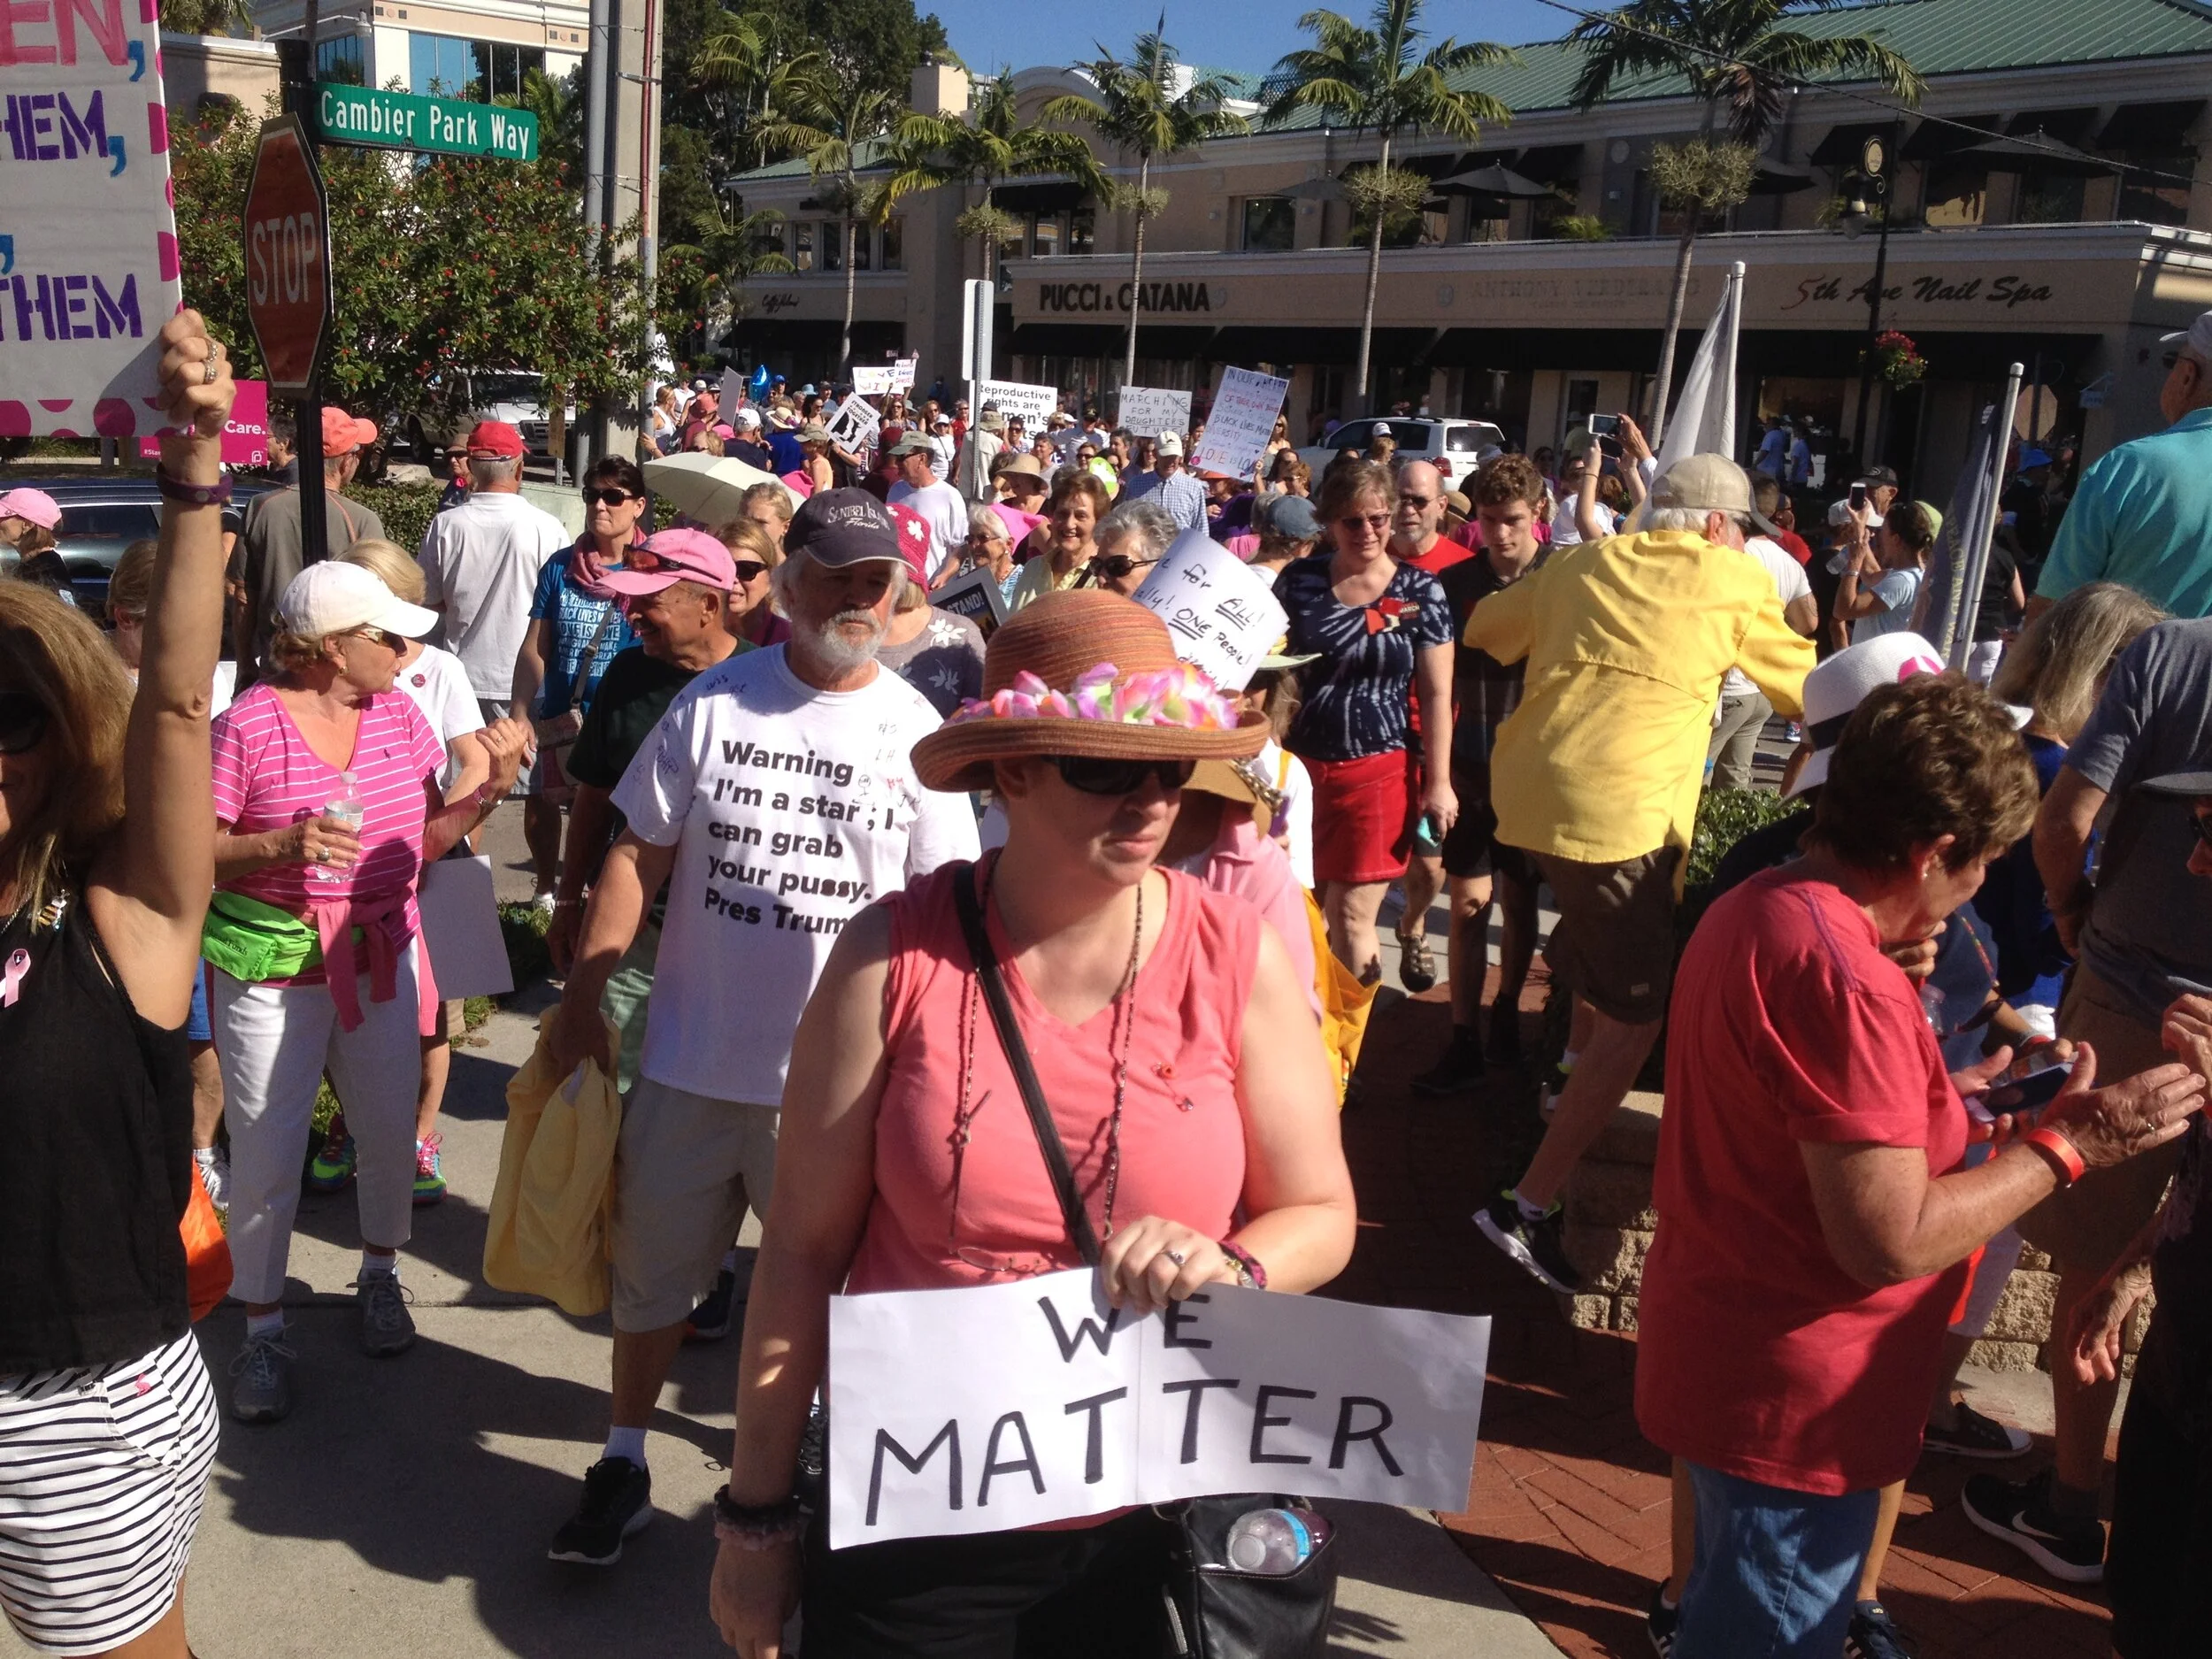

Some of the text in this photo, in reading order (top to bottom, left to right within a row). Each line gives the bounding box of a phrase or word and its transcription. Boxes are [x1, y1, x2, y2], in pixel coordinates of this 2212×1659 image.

[321, 91, 529, 159] Cambier Park Way
[252, 212, 316, 306] STOP
[1040, 282, 1210, 311] PUCCI & CATANA
[1780, 274, 1842, 310] 5th
[1912, 276, 1982, 303] Nail
[1985, 276, 2052, 309] Spa
[1121, 393, 1188, 408] MARCHING
[1162, 409, 1178, 418] MY
[224, 420, 266, 434] Care.
[1125, 416, 1185, 426] DAUGHTERS
[1213, 414, 1238, 427] BLACK
[1199, 447, 1228, 465] LOVE
[845, 518, 879, 530] Florida
[947, 592, 985, 614] STAND!
[1951, 578, 1964, 615] AND
[577, 609, 598, 623] LIVES
[1176, 608, 1212, 634] ONE
[1221, 598, 1265, 627] ALL!
[722, 740, 854, 787] Warning
[713, 779, 763, 808] I'm
[772, 793, 788, 811] a
[799, 798, 859, 823] star
[885, 808, 895, 830] I
[709, 819, 842, 859] can grab
[709, 855, 872, 904] your pussy.
[704, 887, 849, 934] Pres Trum
[1038, 1292, 1213, 1362] WE
[866, 1378, 1404, 1526] MATTER
